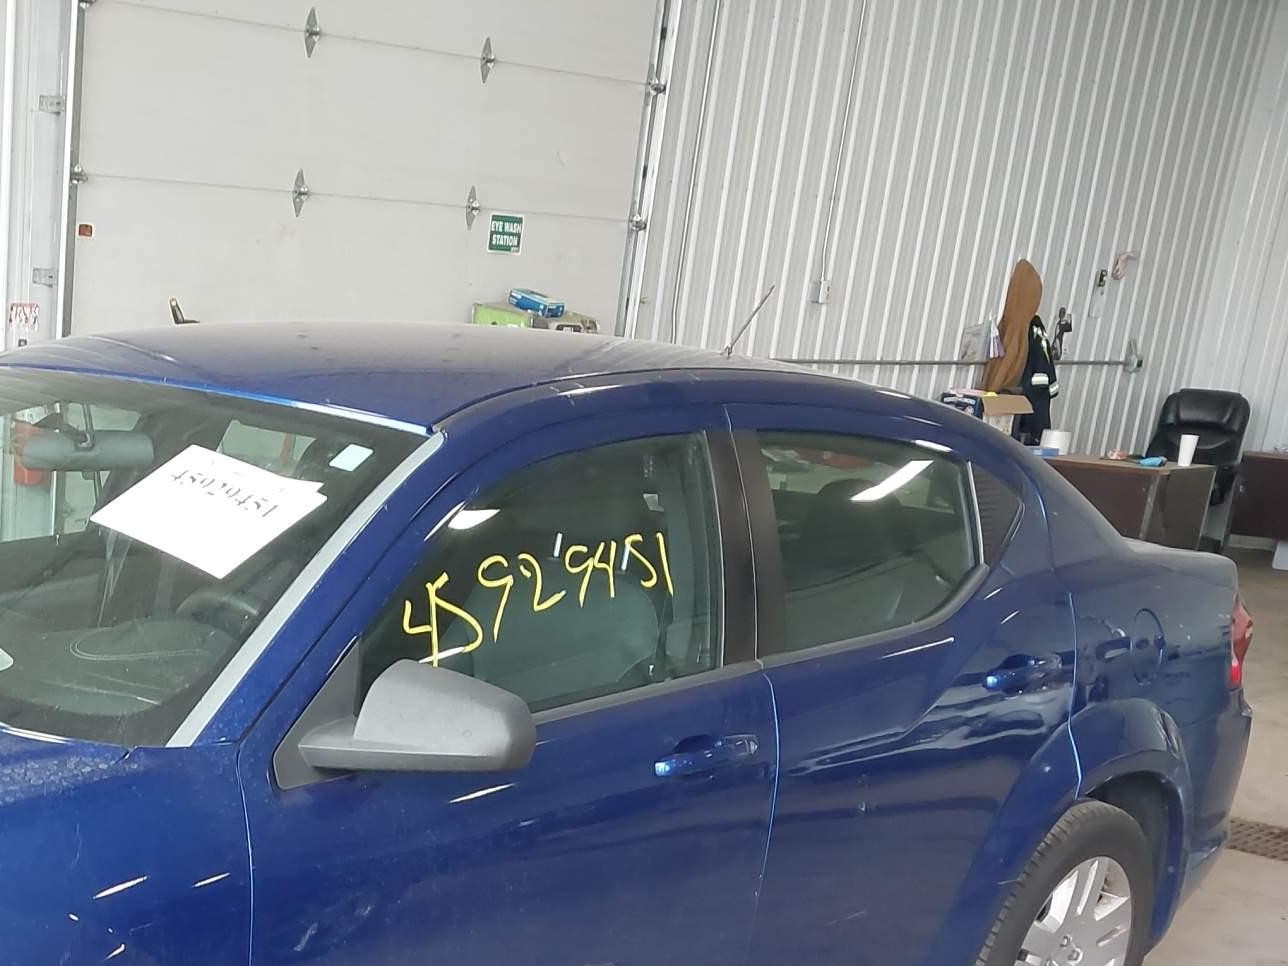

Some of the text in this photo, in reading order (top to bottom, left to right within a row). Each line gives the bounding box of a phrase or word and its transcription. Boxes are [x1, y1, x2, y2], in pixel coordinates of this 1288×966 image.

[491, 221, 521, 234] EYE WASH
[492, 235, 519, 246] STATION
[402, 531, 674, 667] 45929451
